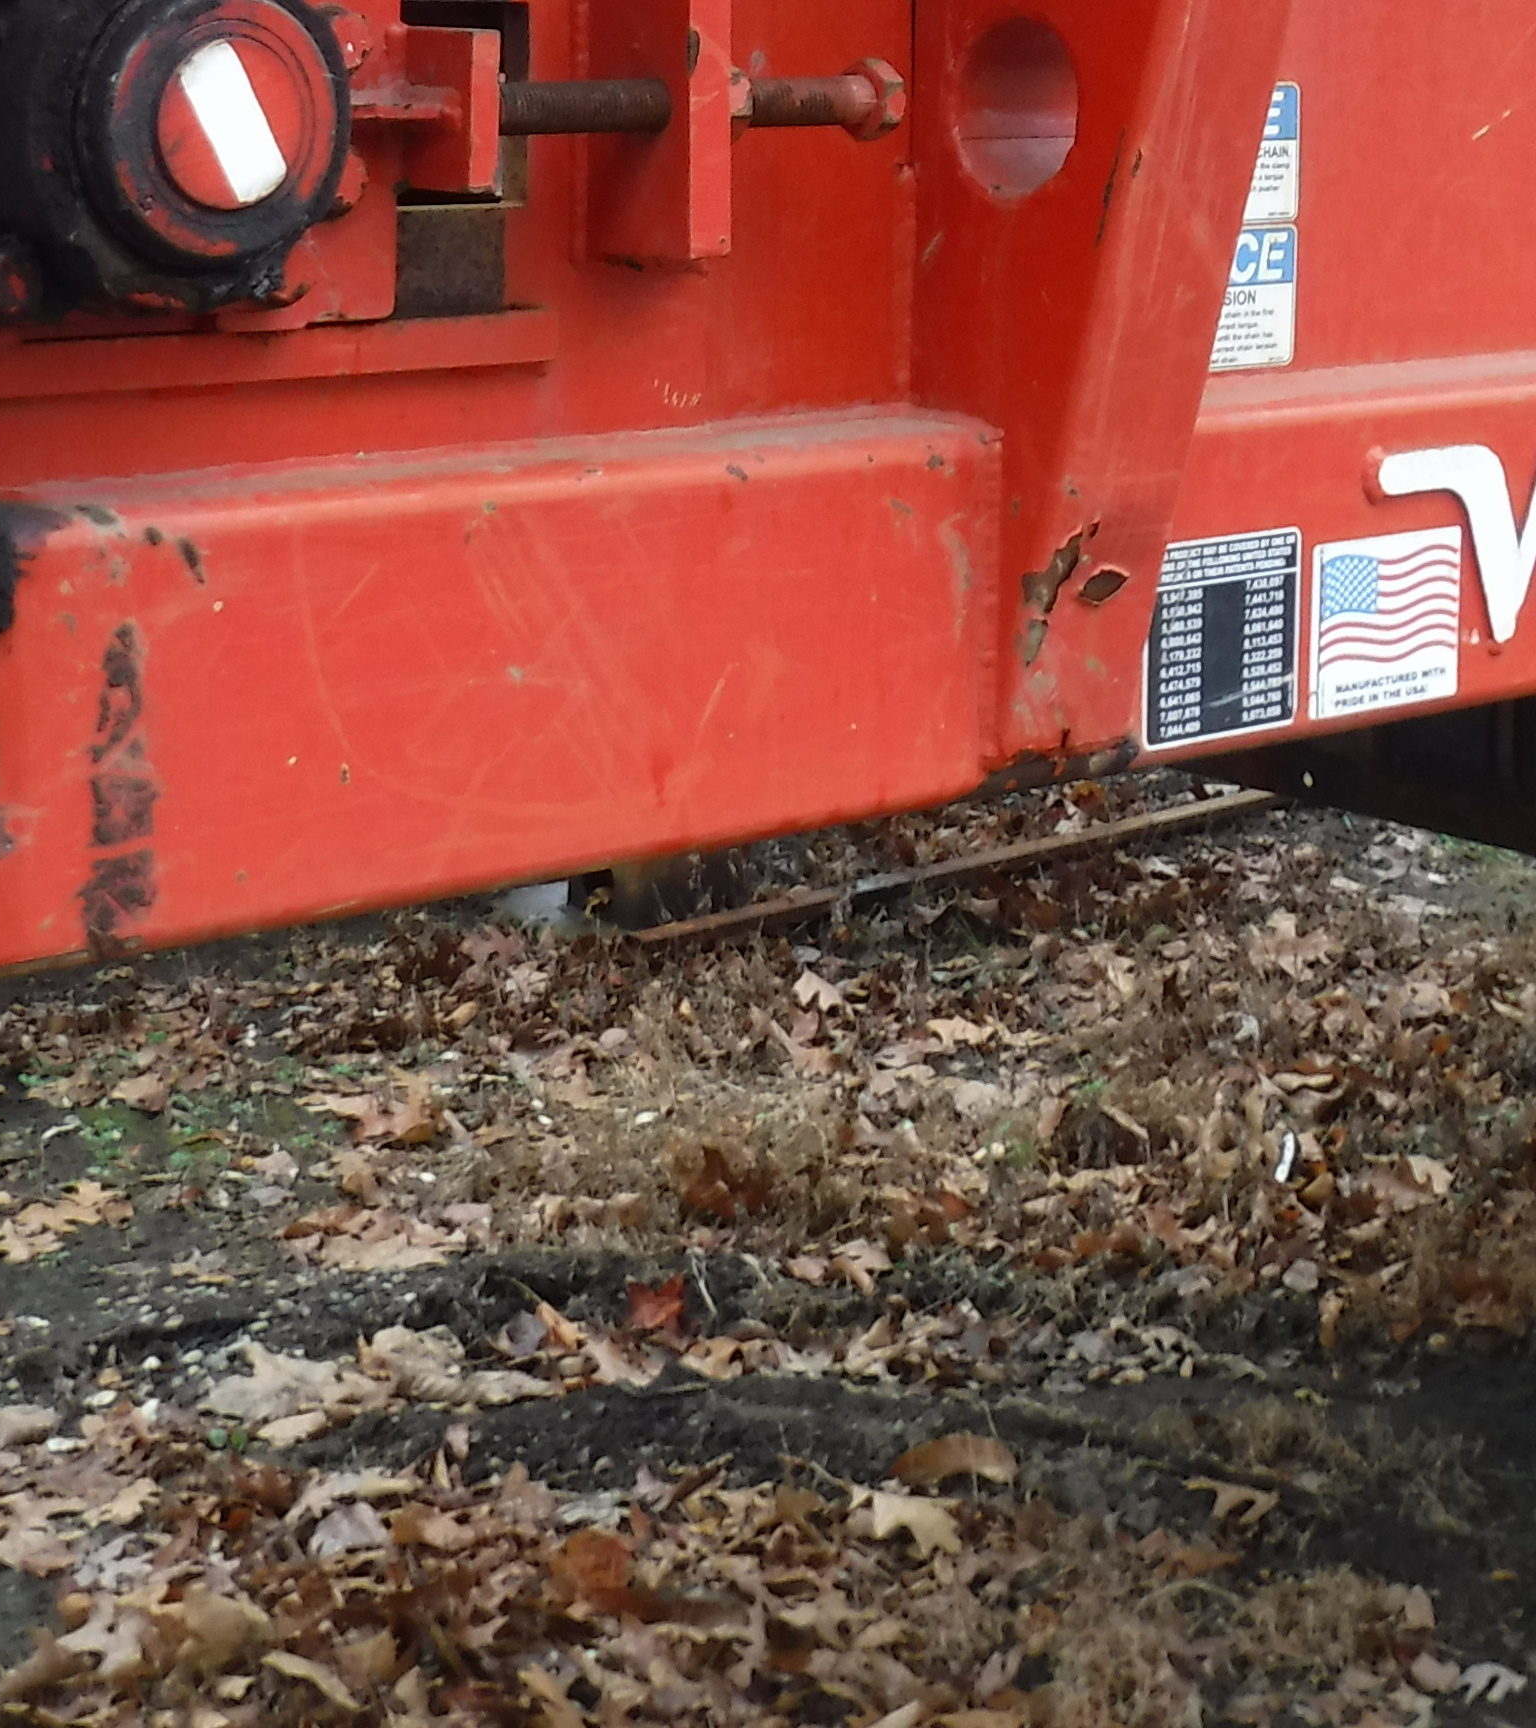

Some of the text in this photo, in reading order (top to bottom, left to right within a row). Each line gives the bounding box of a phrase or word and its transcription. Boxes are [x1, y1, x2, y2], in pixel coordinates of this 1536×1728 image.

[1335, 666, 1447, 694] MANUFACTURED WITH
[1334, 695, 1364, 708] PRIDE
[1369, 692, 1379, 702] IN
[1383, 689, 1401, 699] THE
